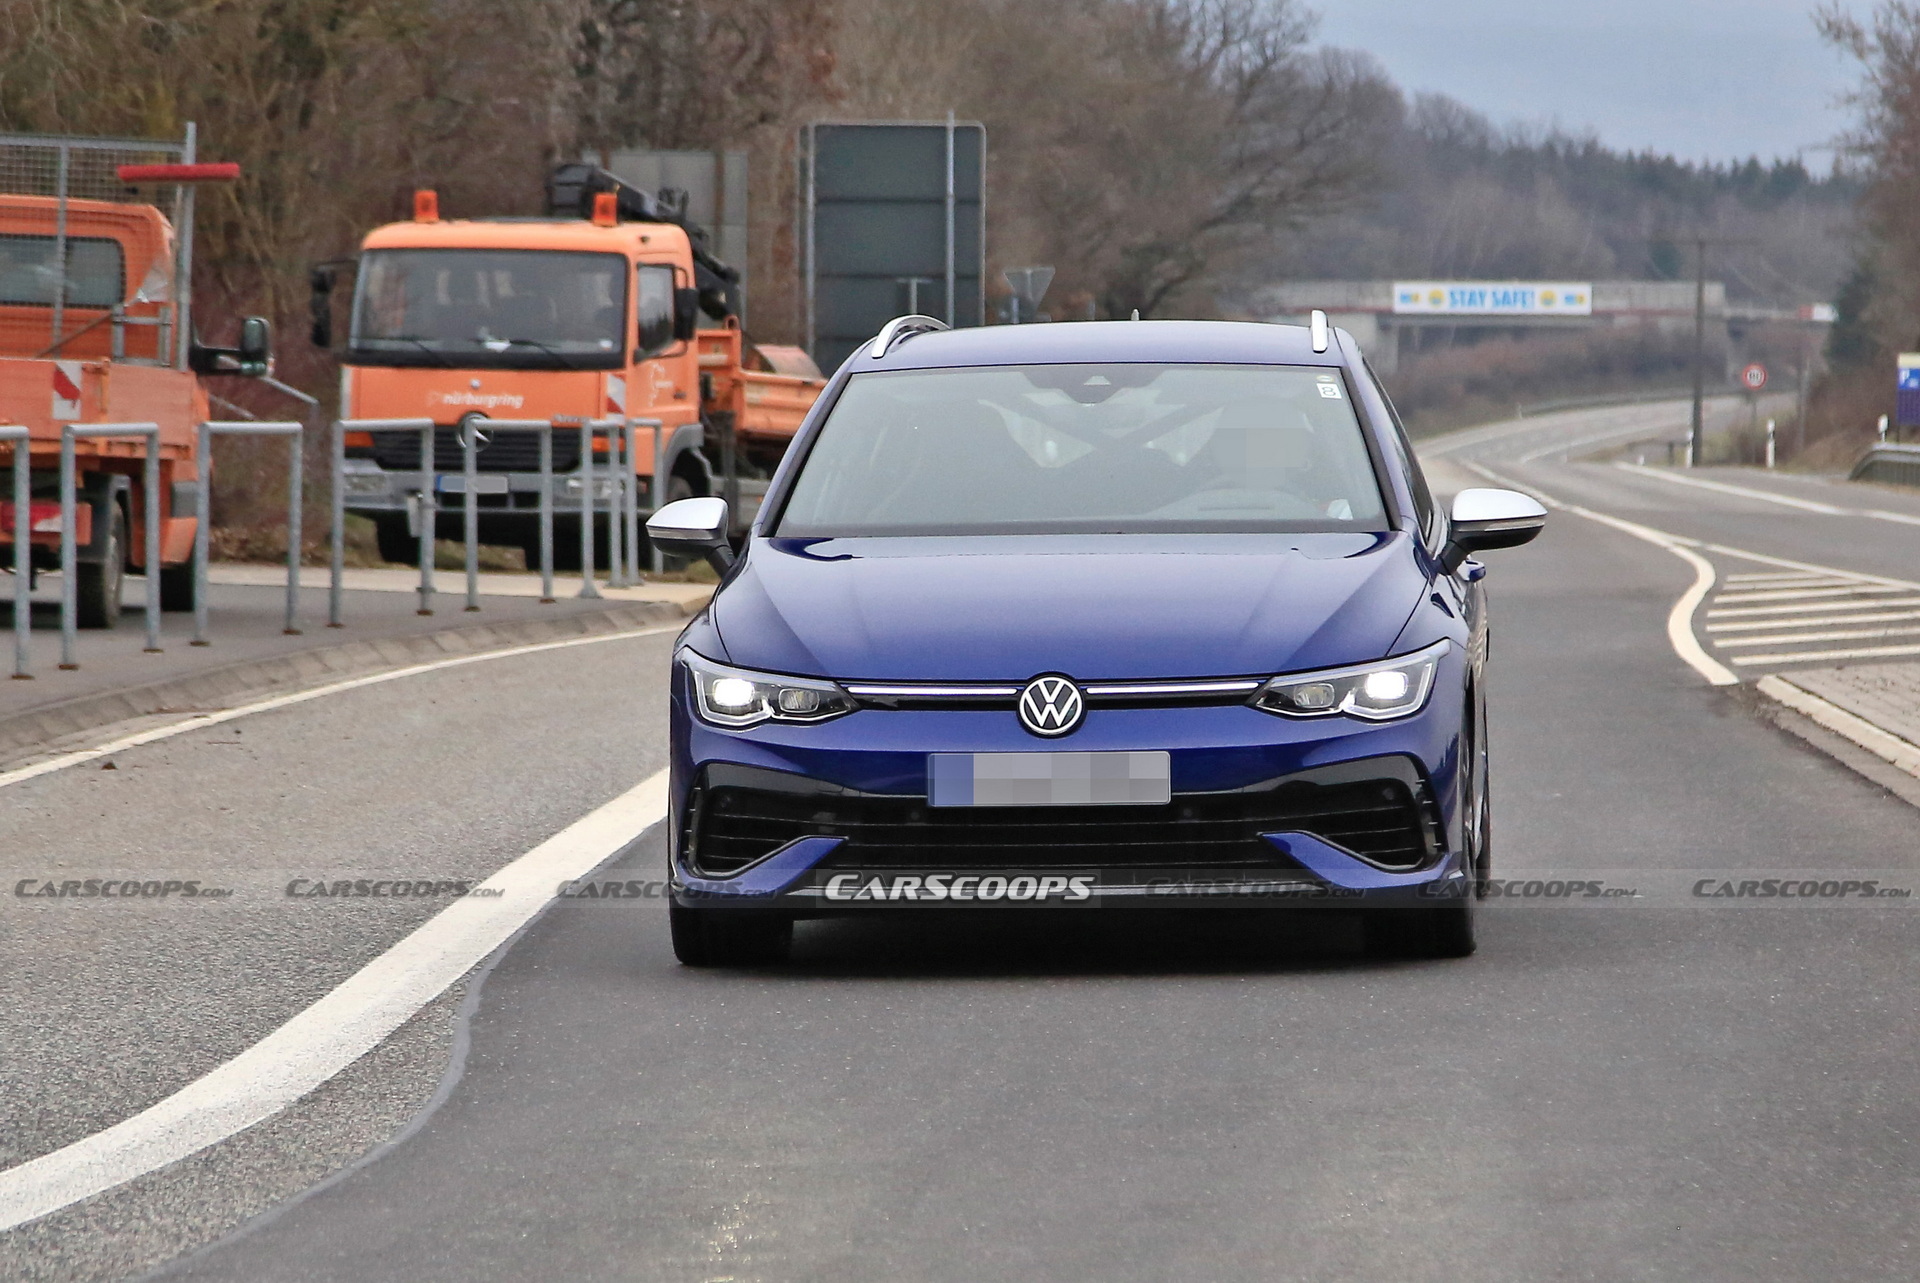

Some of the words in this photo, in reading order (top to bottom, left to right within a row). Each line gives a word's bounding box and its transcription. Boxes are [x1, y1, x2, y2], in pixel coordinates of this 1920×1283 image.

[1449, 290, 1486, 308] STAY
[1492, 289, 1535, 309] SAFE!
[443, 392, 524, 408] nürburgring
[1019, 676, 1083, 735] VW
